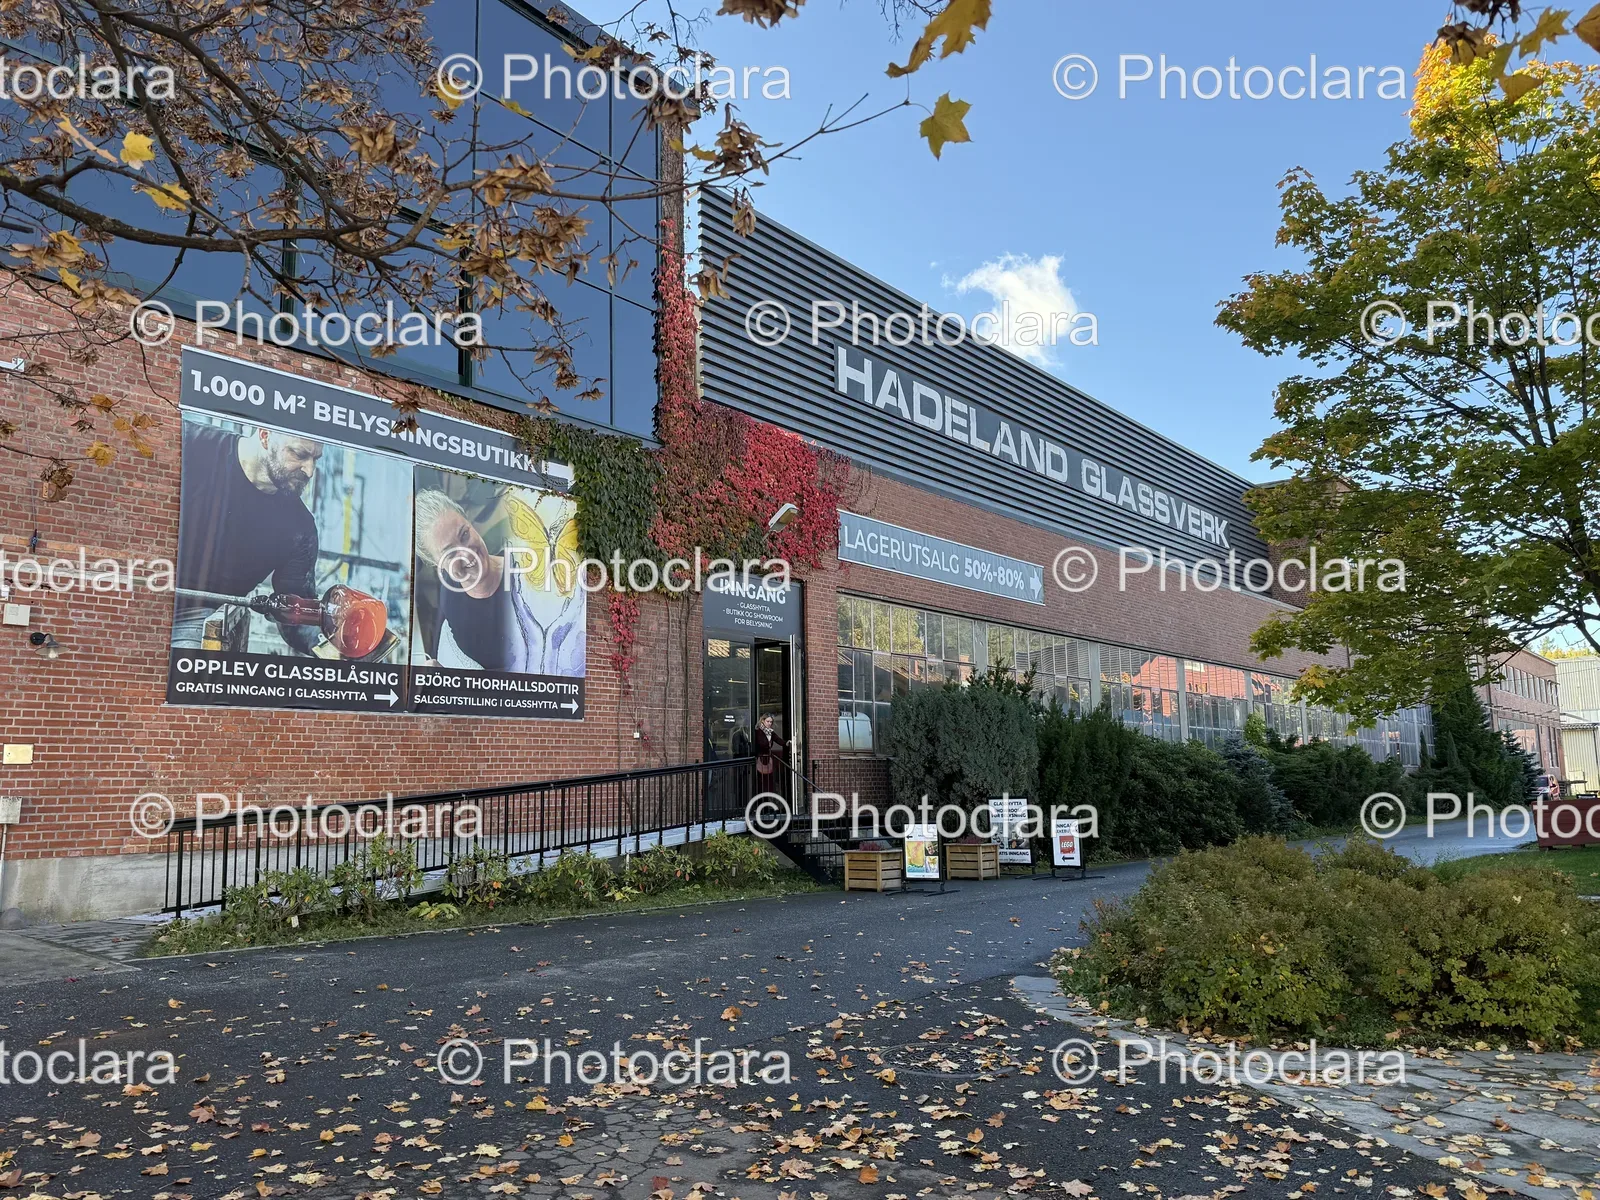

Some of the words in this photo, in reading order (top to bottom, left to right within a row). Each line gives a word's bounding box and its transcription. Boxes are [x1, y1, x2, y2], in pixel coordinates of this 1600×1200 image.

[190, 369, 265, 406] 1.000
[837, 345, 1068, 483] HADELAND
[1081, 458, 1231, 549] GLASSVERK
[844, 525, 960, 575] LAGERUTSALG
[964, 558, 1025, 590] 50%-80%
[720, 578, 786, 605] INNGANG
[726, 608, 745, 617] BUTIKK
[753, 612, 784, 622] SHOWROOM
[740, 602, 771, 613] GLASSHYTTA
[734, 618, 746, 626] FOR
[746, 619, 773, 629] BELYSNING
[176, 658, 259, 677] OPPLEV
[264, 664, 399, 686] GLASSBLÅSING
[415, 672, 461, 688] BJÖRG
[464, 677, 579, 695] THORHALLSDOTTIR
[175, 682, 224, 695] GRATIS
[227, 684, 285, 698] INNGANG
[288, 688, 292, 698] I
[295, 688, 368, 702] GLASSHYTTA
[414, 694, 498, 708] SALGSUTSTILLING
[504, 699, 559, 710] GLASSHYTTA
